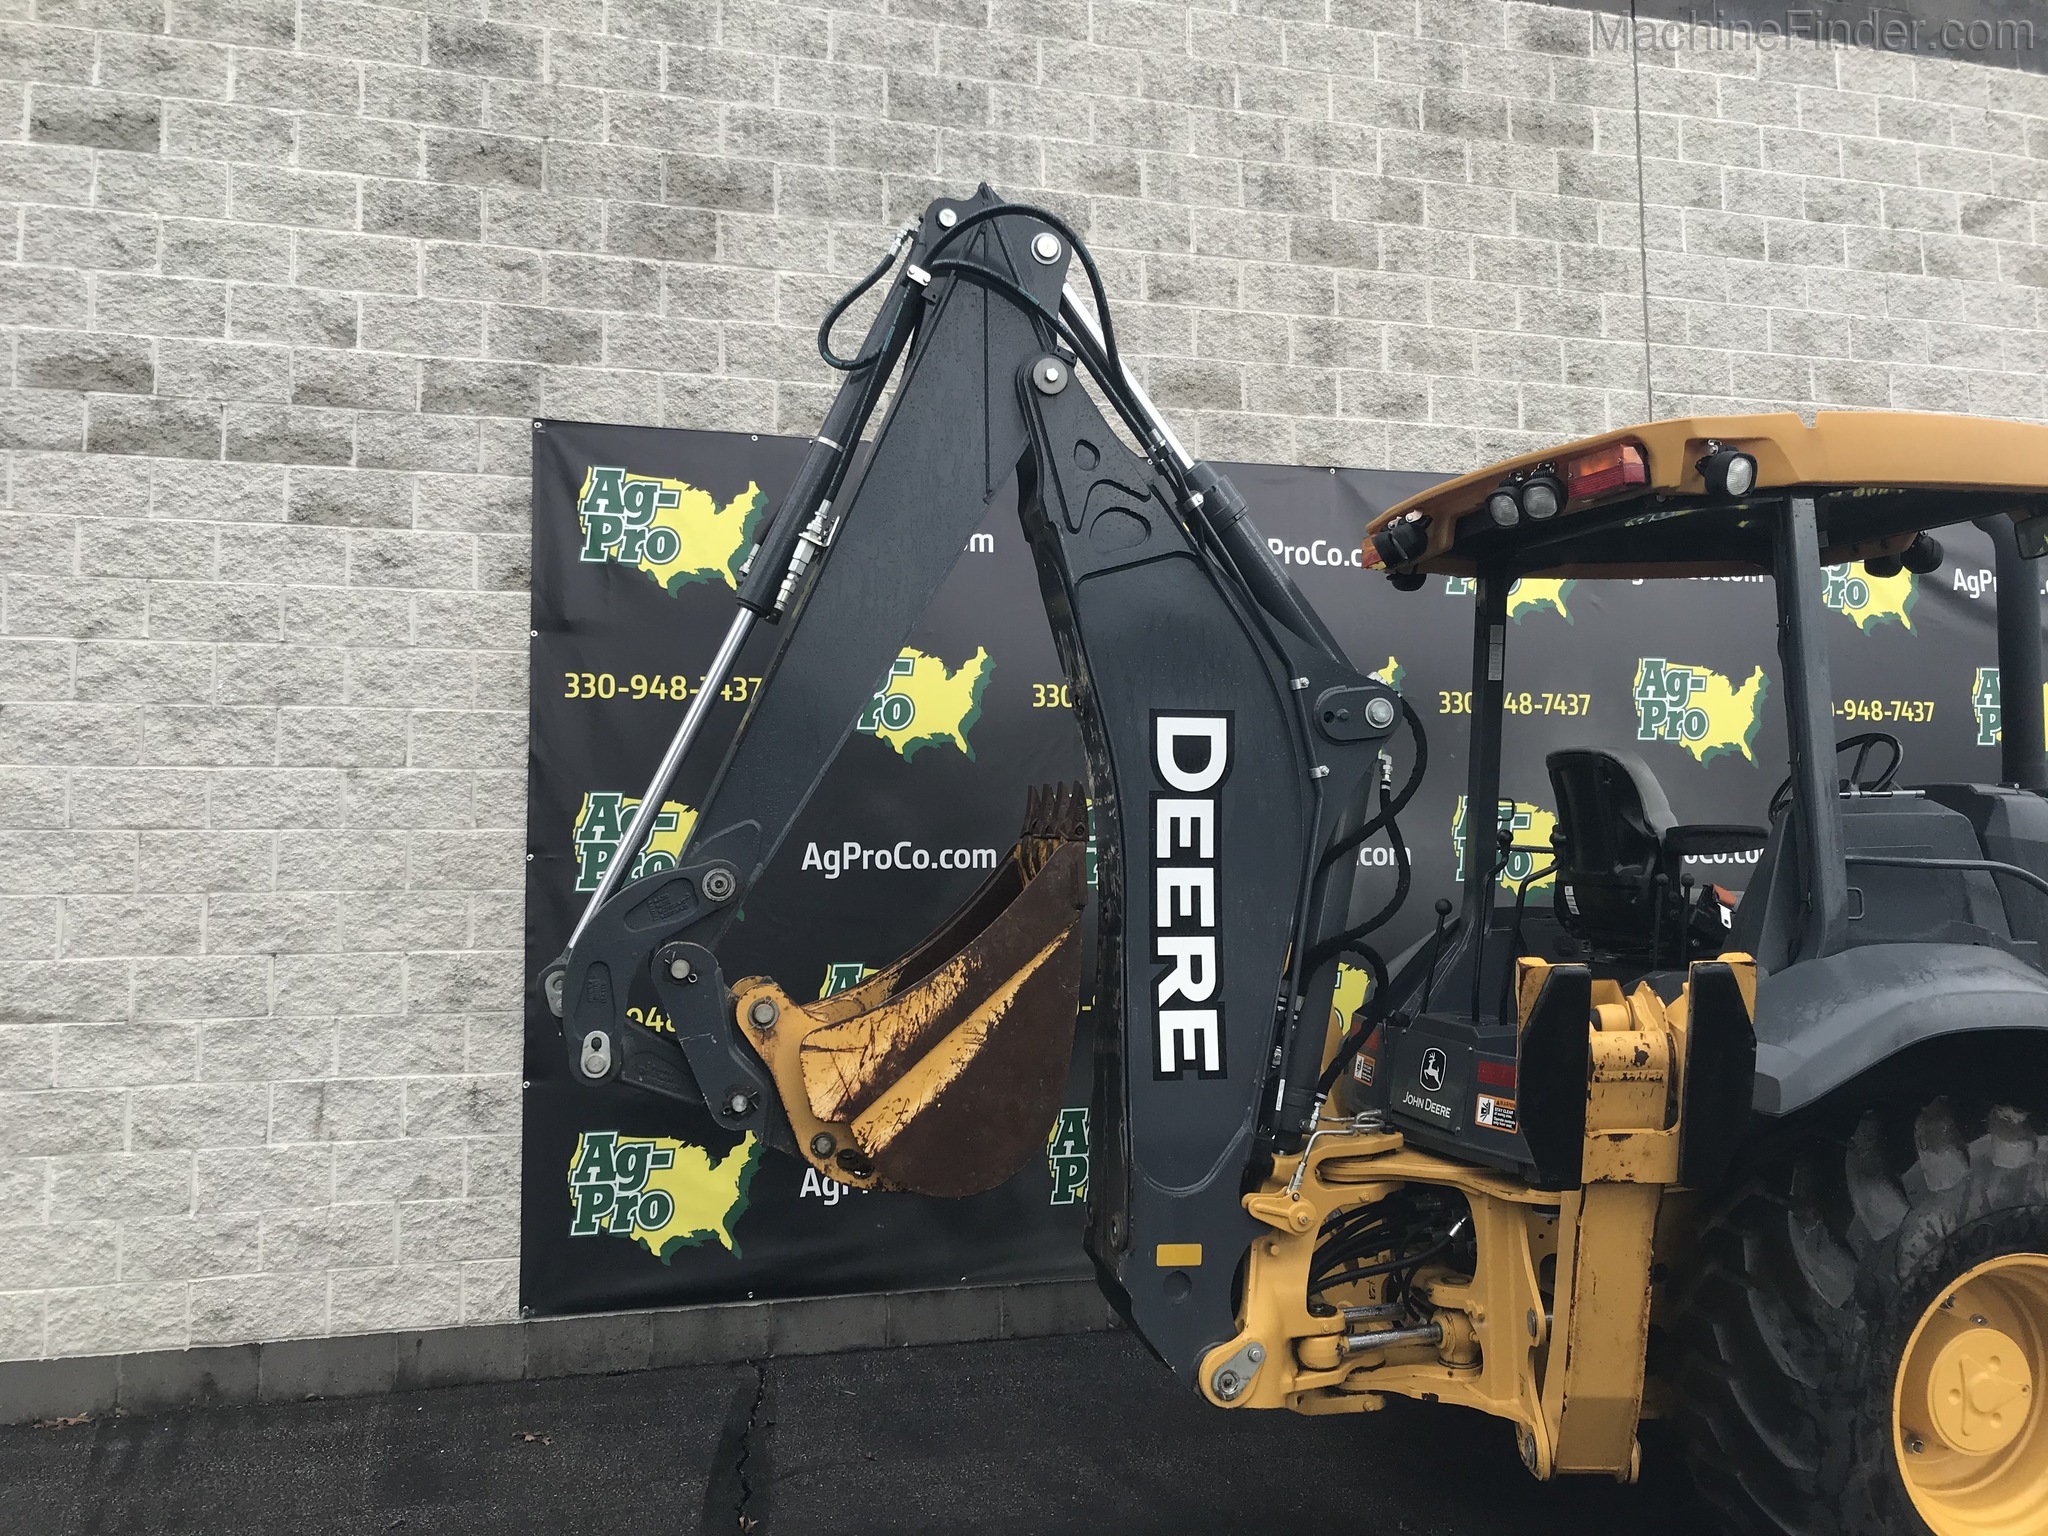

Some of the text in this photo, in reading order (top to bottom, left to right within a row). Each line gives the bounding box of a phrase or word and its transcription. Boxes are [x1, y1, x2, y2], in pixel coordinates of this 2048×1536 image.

[579, 465, 681, 527] Ag-
[579, 512, 681, 565] Pro
[1636, 658, 1707, 709] Ag-
[1637, 698, 1708, 740] Pro
[1831, 699, 1935, 722] -948-7437
[801, 841, 997, 880] AgProCo.com
[1156, 716, 1227, 1073] DEERE
[1403, 1091, 1452, 1119] JOHN DEERE
[571, 1132, 674, 1196] Ag-
[571, 1181, 674, 1235] Pro
